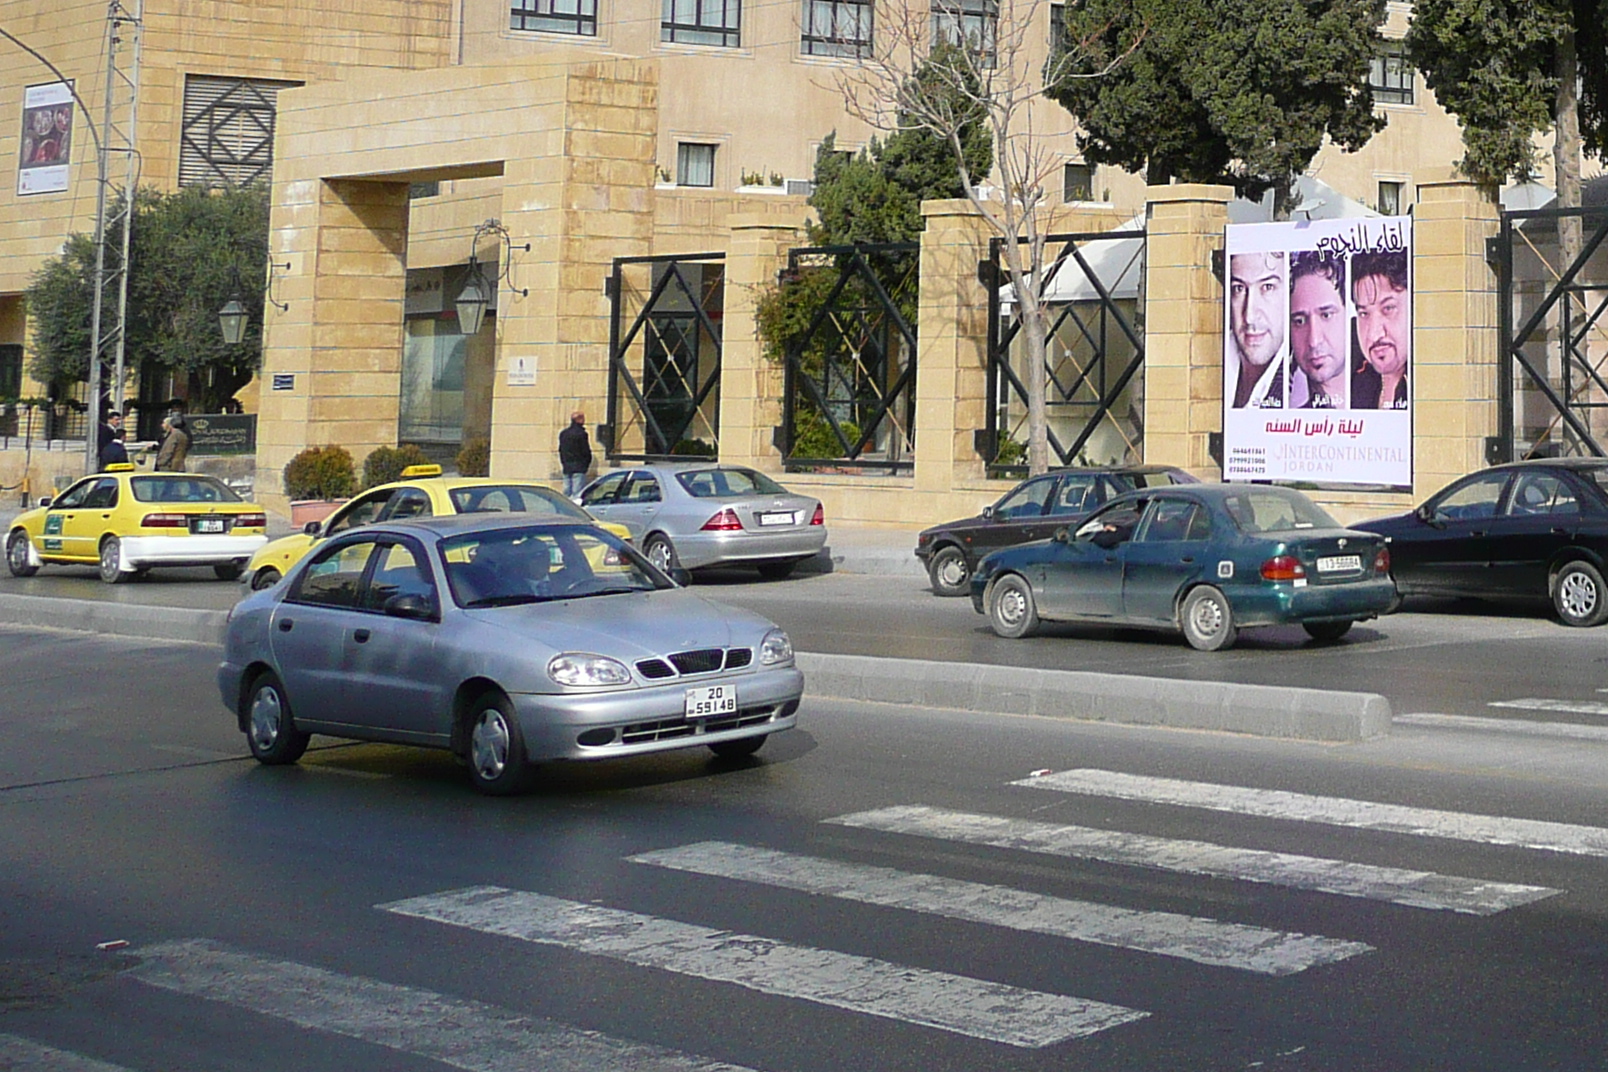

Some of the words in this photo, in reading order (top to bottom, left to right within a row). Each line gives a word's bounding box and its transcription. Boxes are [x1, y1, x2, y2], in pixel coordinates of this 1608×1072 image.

[1316, 222, 1370, 262] النجوم
[1377, 221, 1404, 252] لقاء
[1305, 416, 1334, 436] رأس
[1338, 418, 1364, 438] ليلة
[1283, 461, 1334, 474] JORDAN
[708, 687, 723, 700] 20
[696, 698, 734, 714] 59148
